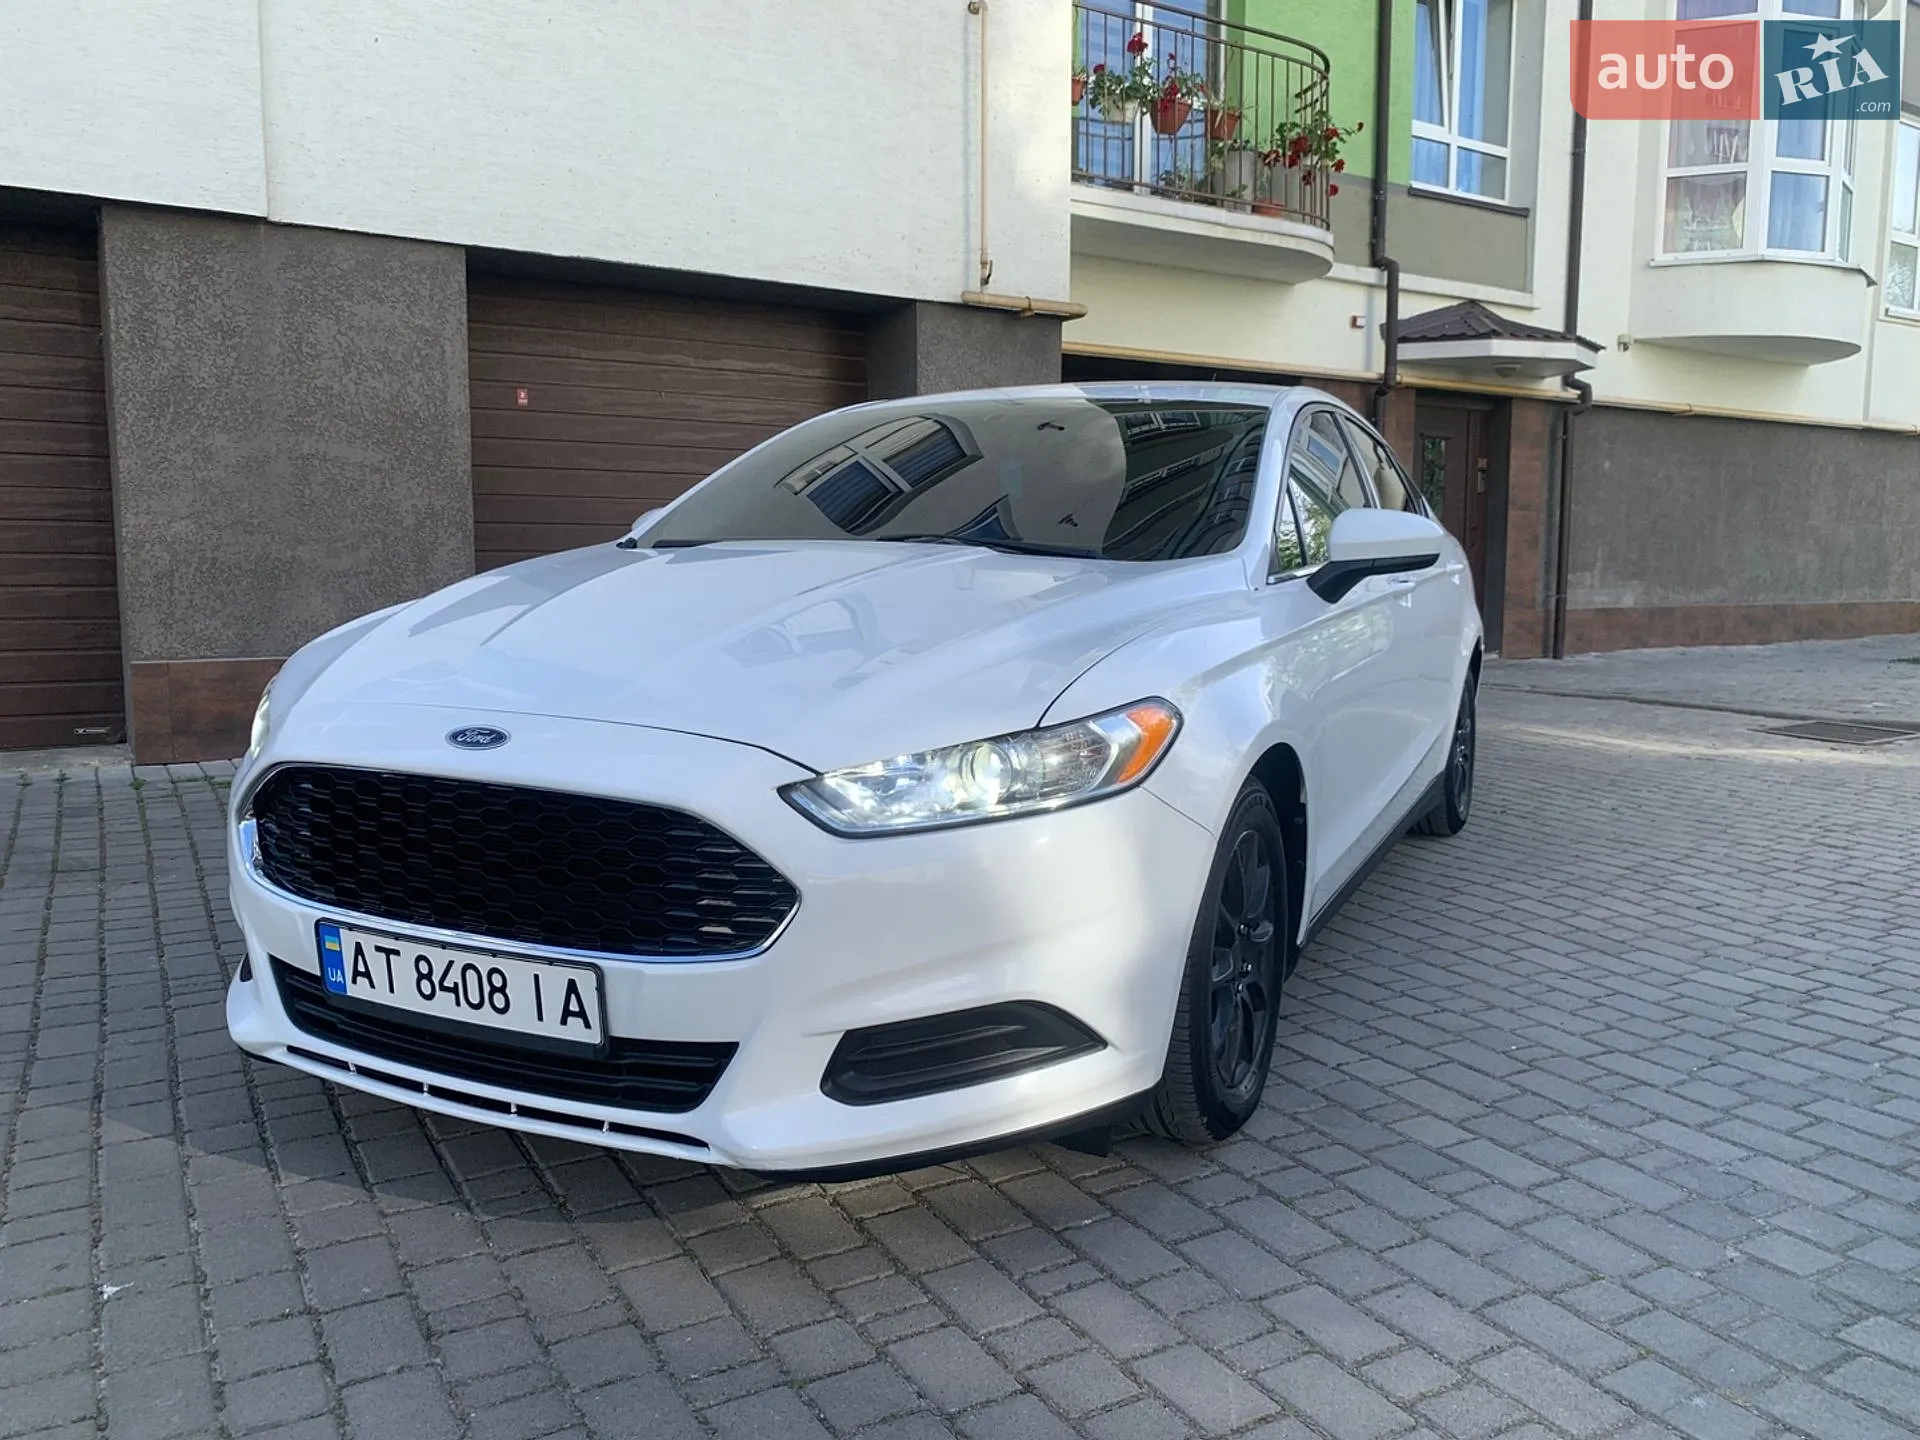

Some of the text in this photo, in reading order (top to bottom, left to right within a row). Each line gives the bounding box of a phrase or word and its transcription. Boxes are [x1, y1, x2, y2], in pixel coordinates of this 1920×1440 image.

[457, 729, 498, 744] Ford
[328, 967, 344, 984] UA
[351, 941, 401, 994] AT
[414, 954, 511, 1015] 8408
